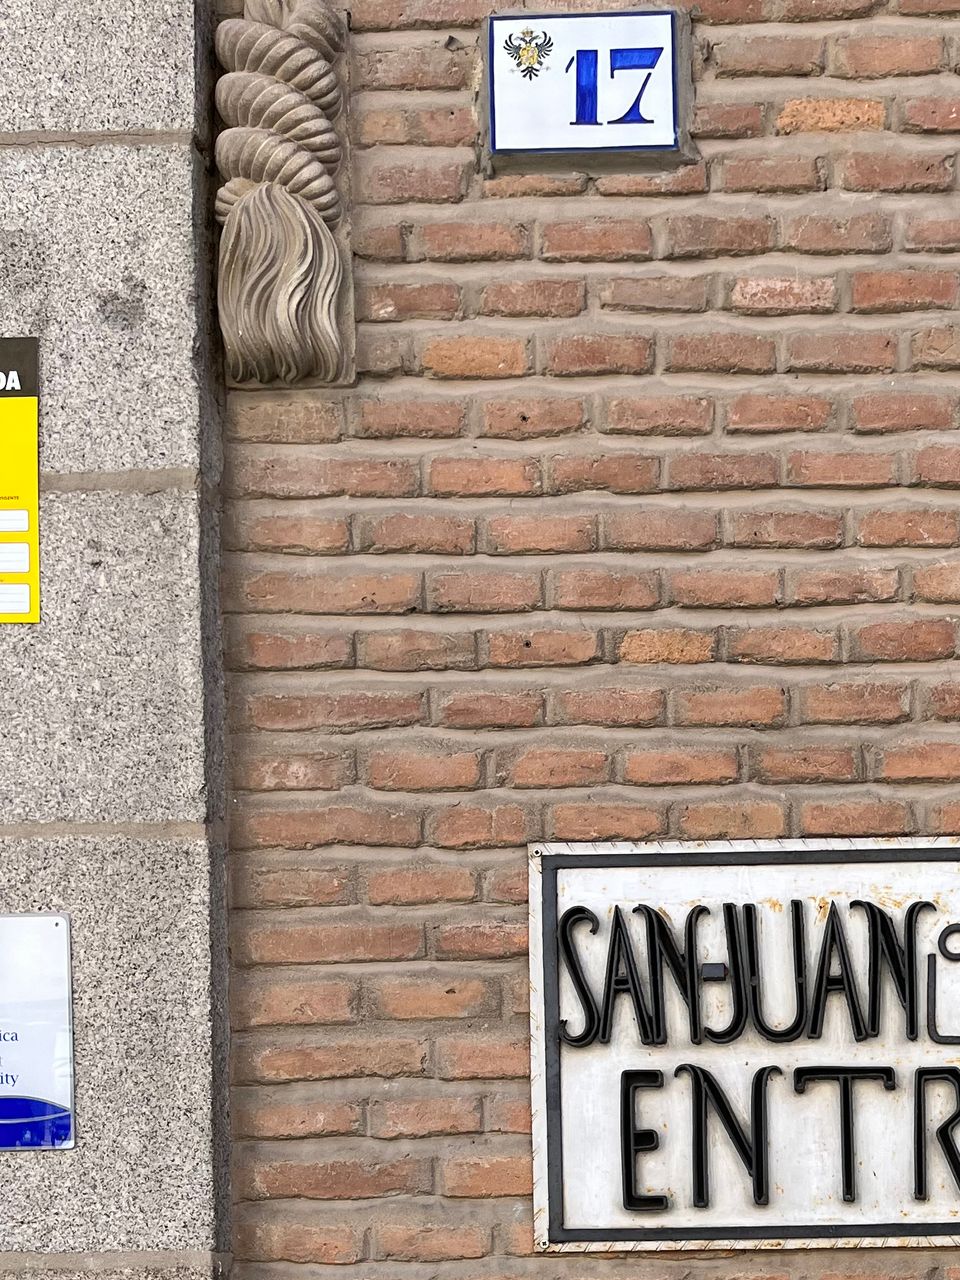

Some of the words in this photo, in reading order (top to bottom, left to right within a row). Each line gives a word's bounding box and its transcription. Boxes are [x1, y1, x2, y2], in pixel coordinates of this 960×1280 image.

[565, 47, 664, 126] 17
[558, 903, 710, 1048] SAN
[702, 899, 937, 1044] JUAN
